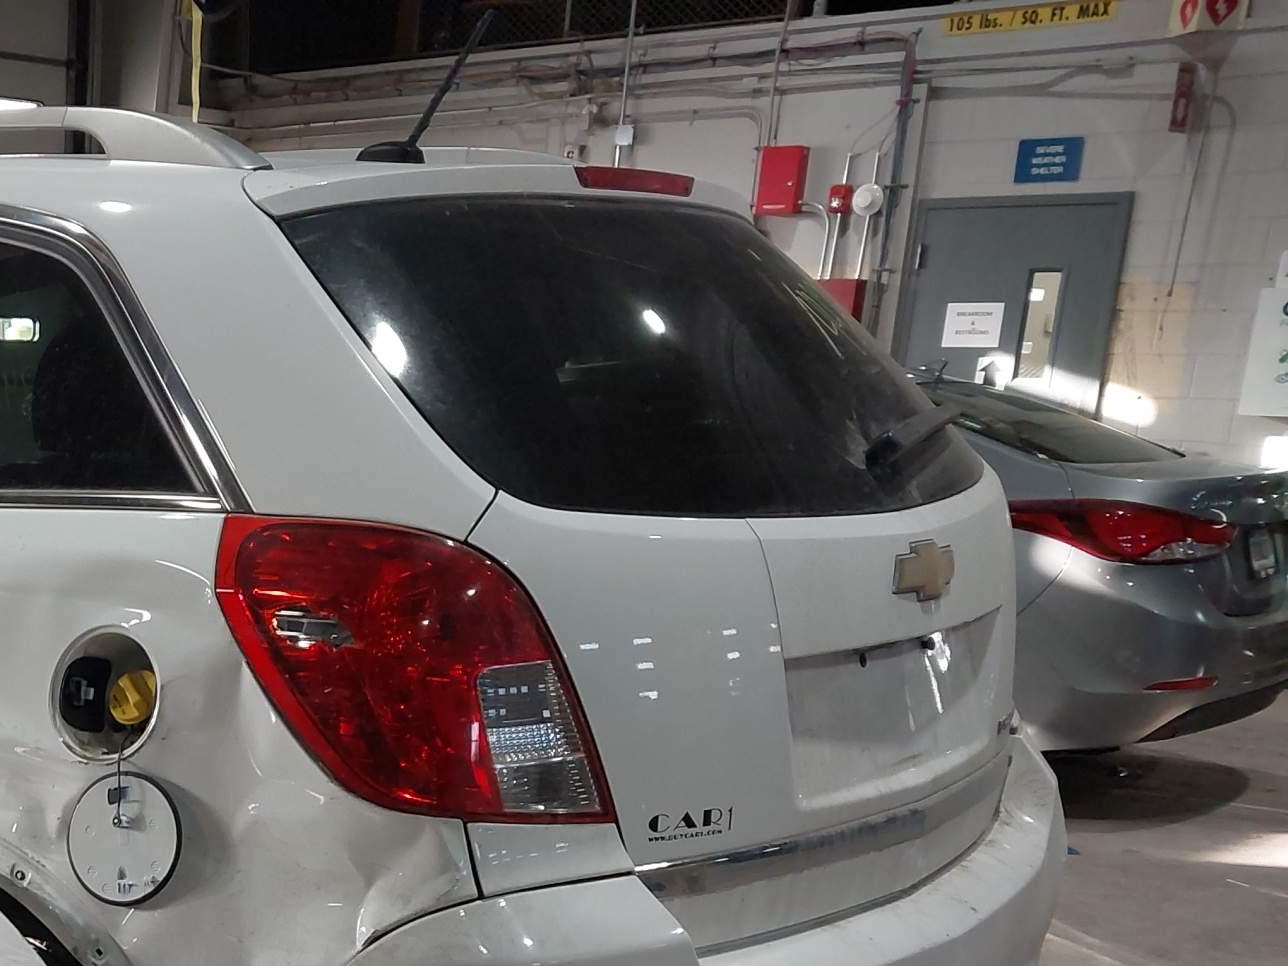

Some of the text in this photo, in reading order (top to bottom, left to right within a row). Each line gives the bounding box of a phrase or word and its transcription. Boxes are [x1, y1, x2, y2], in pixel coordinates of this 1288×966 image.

[949, 1, 1112, 33] 105 lbs. / SQ. FT. MAX
